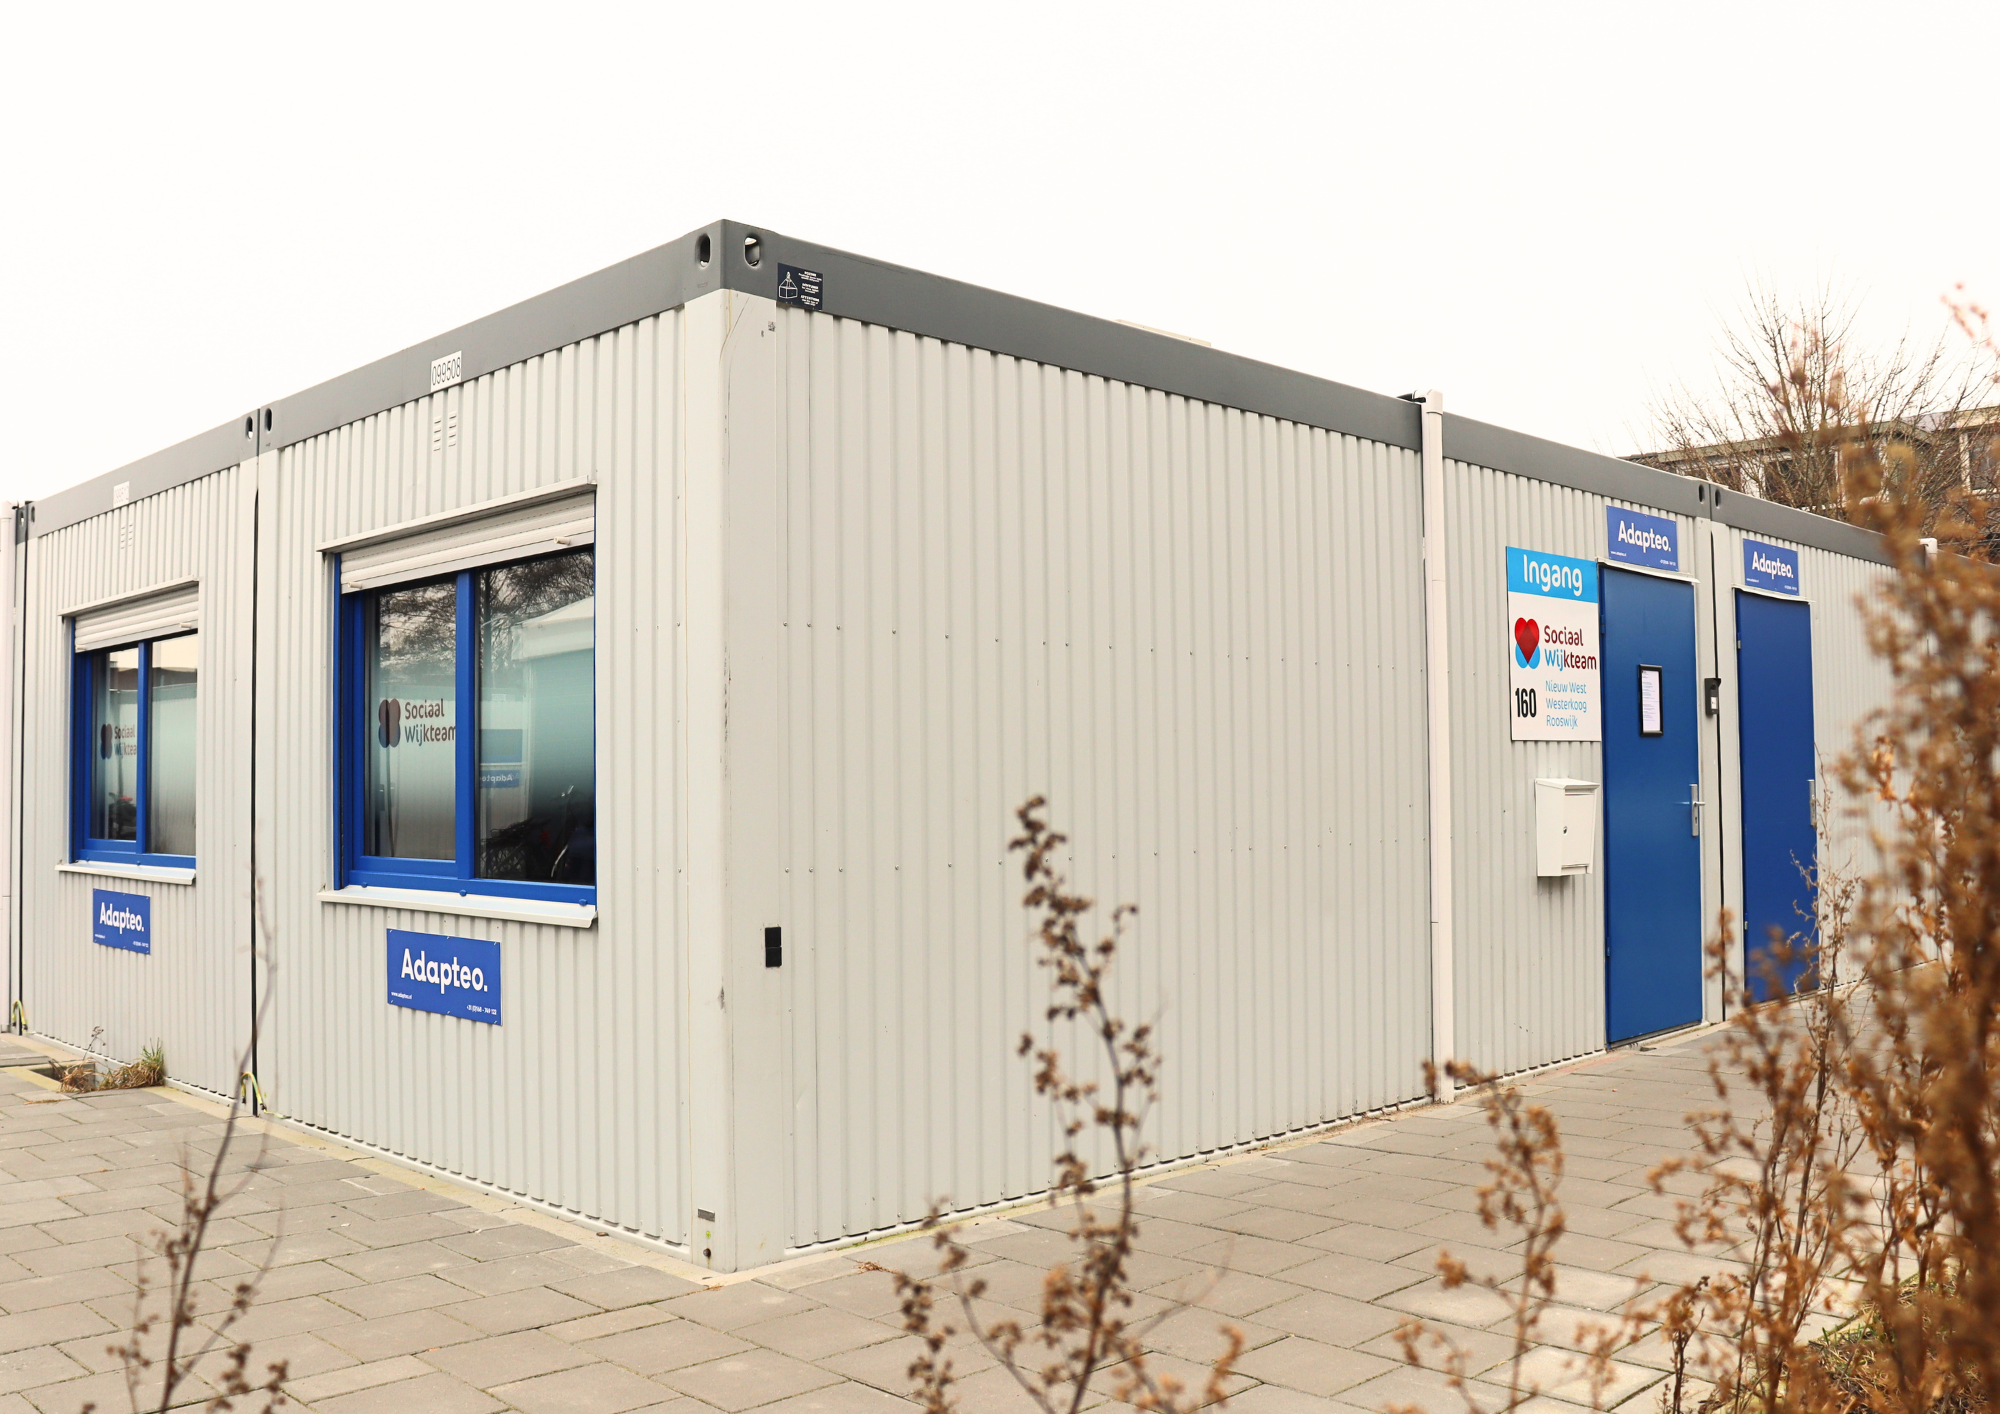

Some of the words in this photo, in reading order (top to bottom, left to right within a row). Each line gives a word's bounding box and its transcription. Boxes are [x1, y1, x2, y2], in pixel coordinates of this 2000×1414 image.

[432, 357, 460, 386] 099508
[1618, 520, 1672, 553] Adapteo.
[1523, 554, 1583, 597] Ingang
[1752, 551, 1794, 580] Adapteo.
[1544, 625, 1584, 646] Sociaal
[1544, 648, 1597, 671] Wijkteam
[1545, 680, 1568, 693] Nieuw
[1569, 682, 1587, 694] West
[404, 698, 445, 720] Sociaal
[1515, 688, 1537, 718] 160
[1545, 698, 1587, 713] Westerkoog
[1546, 715, 1578, 729] Rooswijk
[114, 742, 137, 759] Wijktea
[100, 902, 144, 934] Adapteo.
[401, 948, 488, 994] Adapteo.
